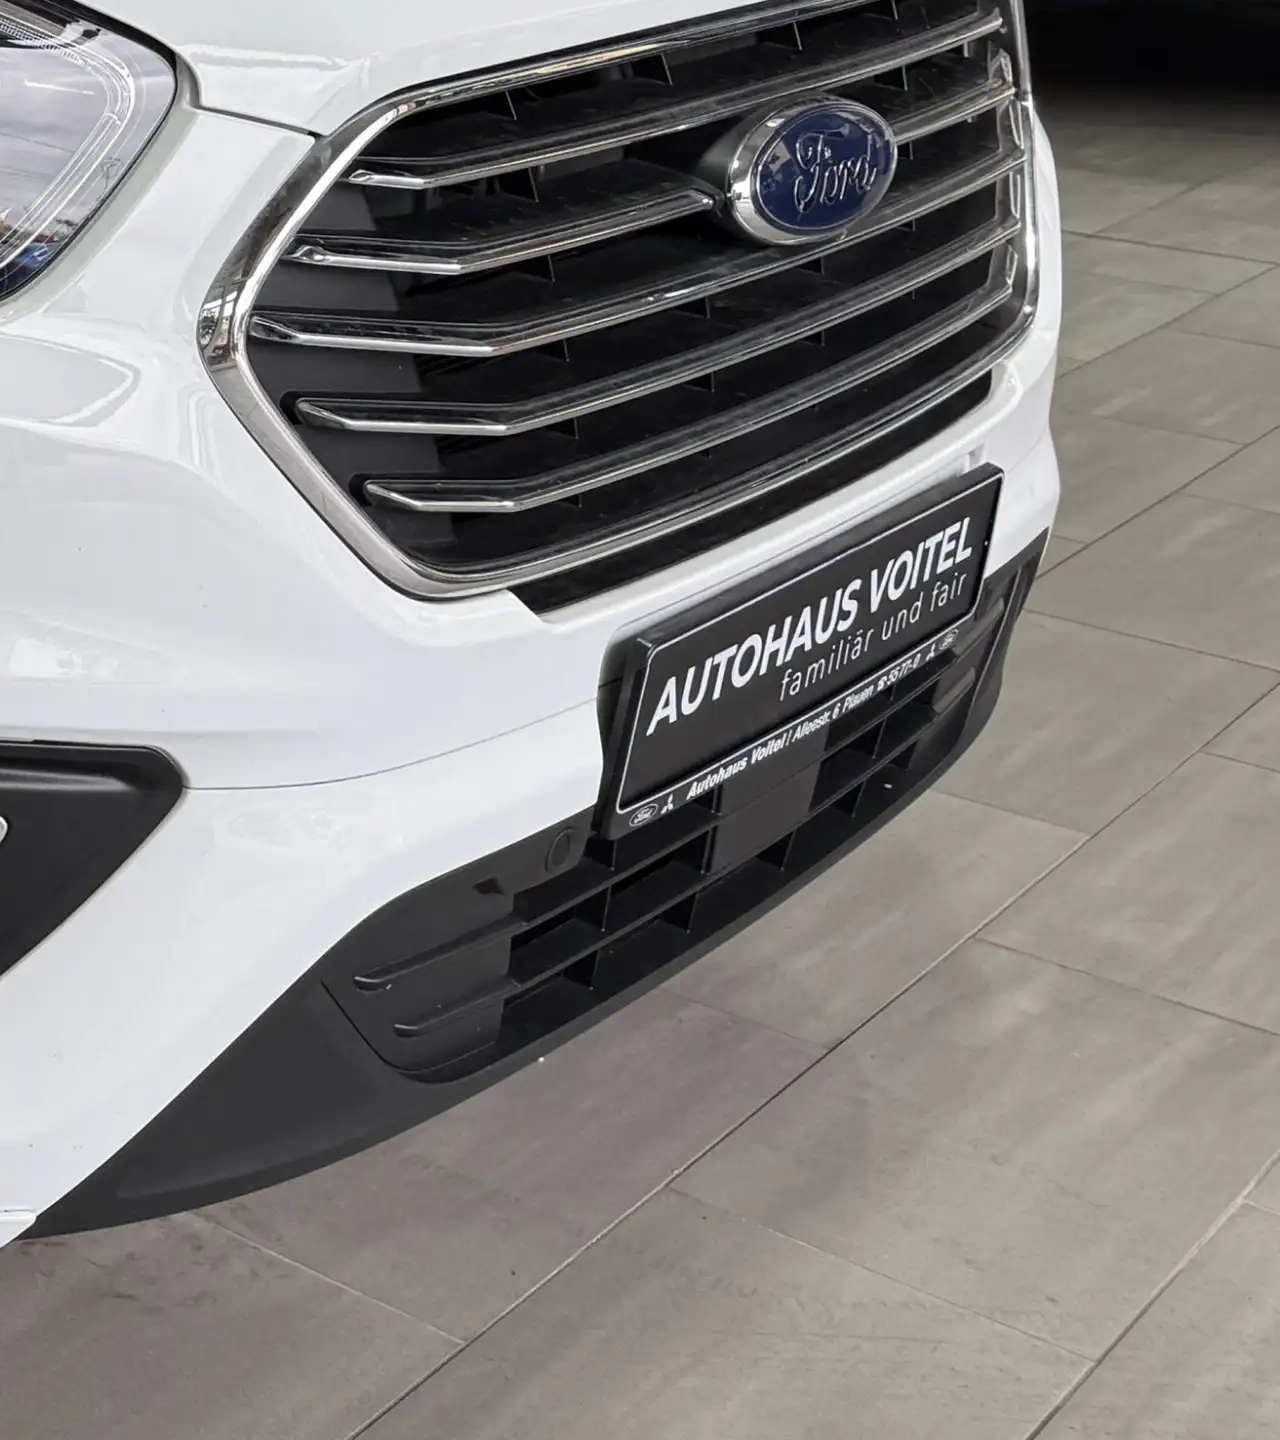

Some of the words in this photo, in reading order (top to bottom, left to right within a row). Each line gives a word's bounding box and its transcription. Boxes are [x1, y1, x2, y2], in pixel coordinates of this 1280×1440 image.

[793, 124, 878, 214] Ford
[646, 578, 862, 737] AUTOHAUS
[870, 516, 973, 613] VOITEL
[780, 628, 875, 702] familiär
[881, 590, 923, 642] und
[930, 571, 968, 613] fair
[686, 757, 749, 801] Autohaus
[751, 732, 786, 765] Voitel
[832, 702, 841, 720] 6
[842, 684, 875, 713] Plauen
